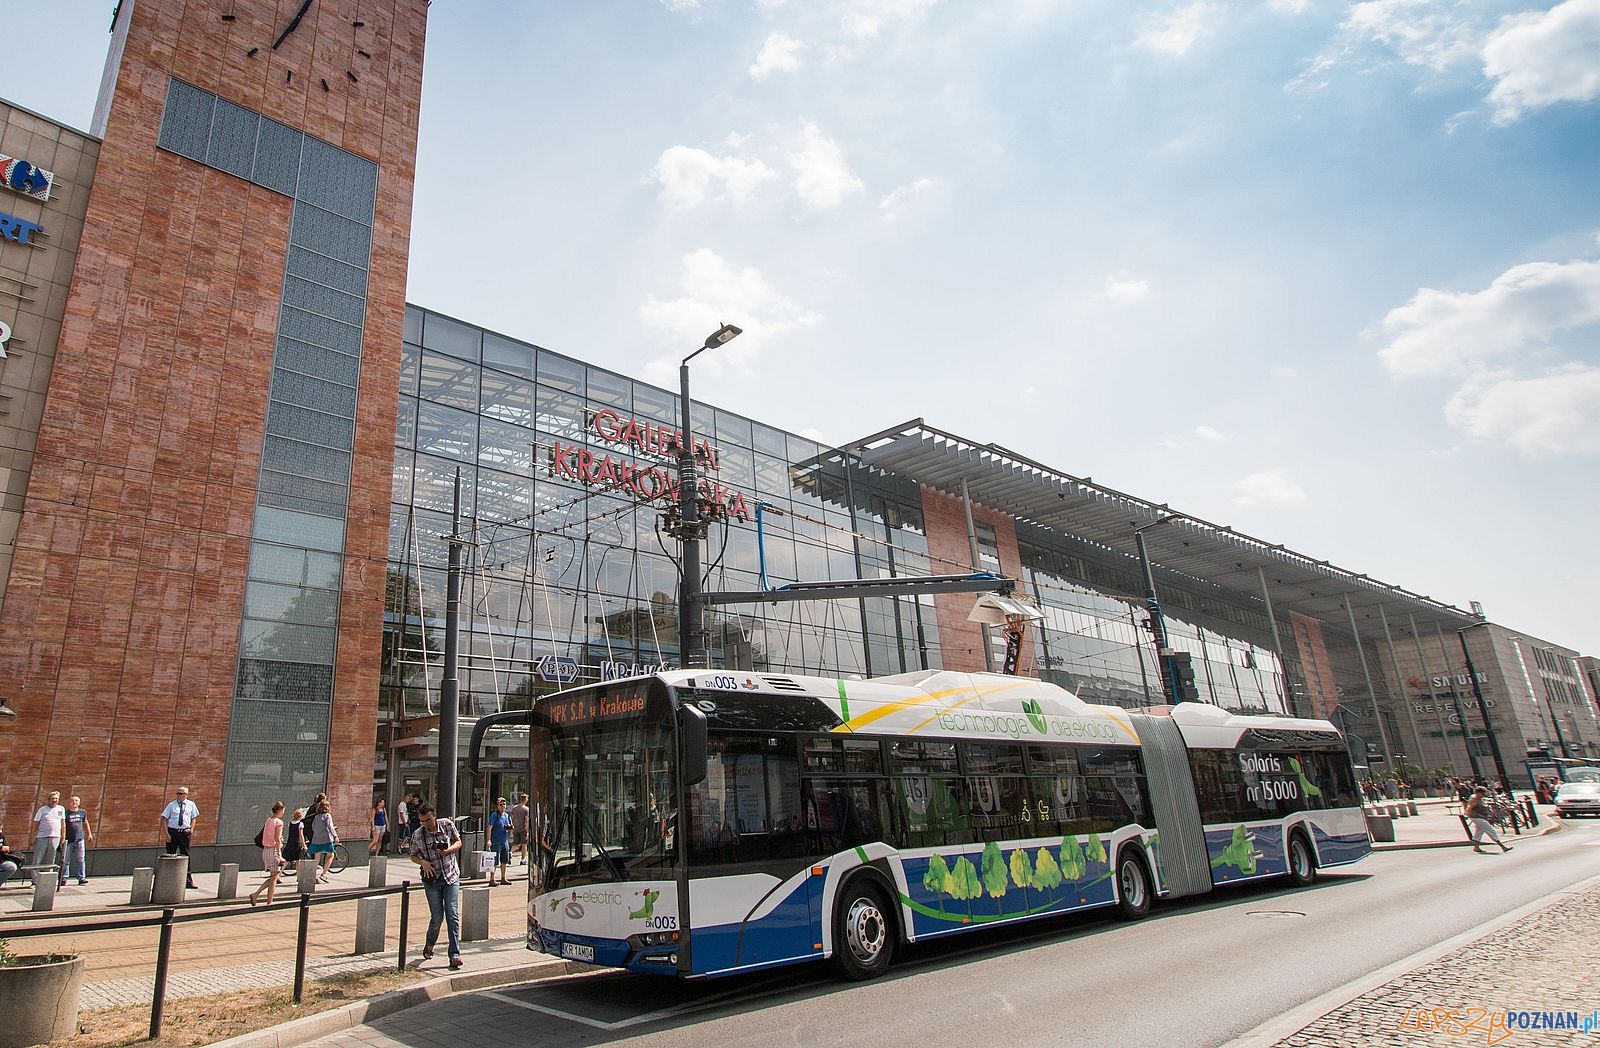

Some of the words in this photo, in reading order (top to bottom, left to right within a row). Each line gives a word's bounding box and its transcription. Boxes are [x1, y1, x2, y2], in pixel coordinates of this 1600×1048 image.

[546, 662, 576, 675] PKP
[705, 675, 738, 690] DN003
[550, 704, 566, 724] MPK
[600, 694, 644, 717] Krakowie
[1239, 753, 1281, 773] Solaris
[1246, 786, 1260, 802] nr
[645, 915, 677, 930] DN003
